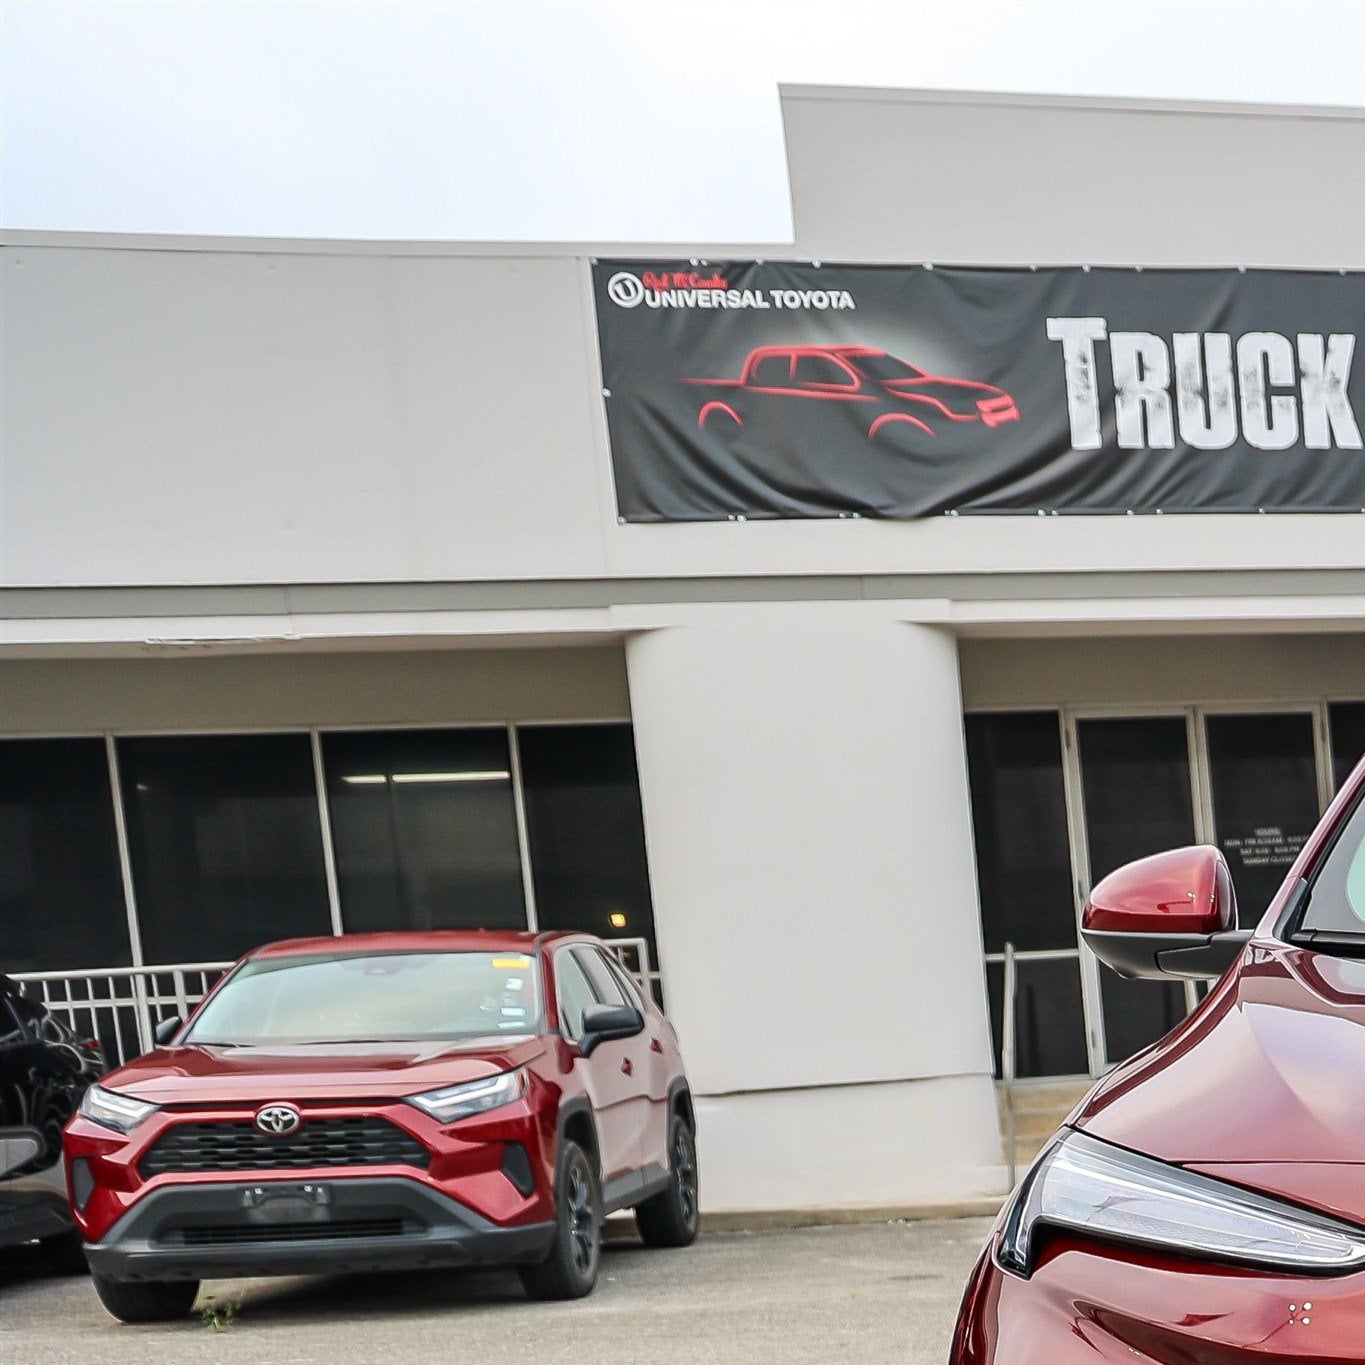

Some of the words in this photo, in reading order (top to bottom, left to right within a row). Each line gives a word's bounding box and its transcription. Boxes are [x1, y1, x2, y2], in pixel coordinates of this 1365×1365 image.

[644, 289, 771, 309] UNIVERSAL
[769, 289, 856, 310] TOYOTA
[1046, 316, 1364, 451] TRUCK
